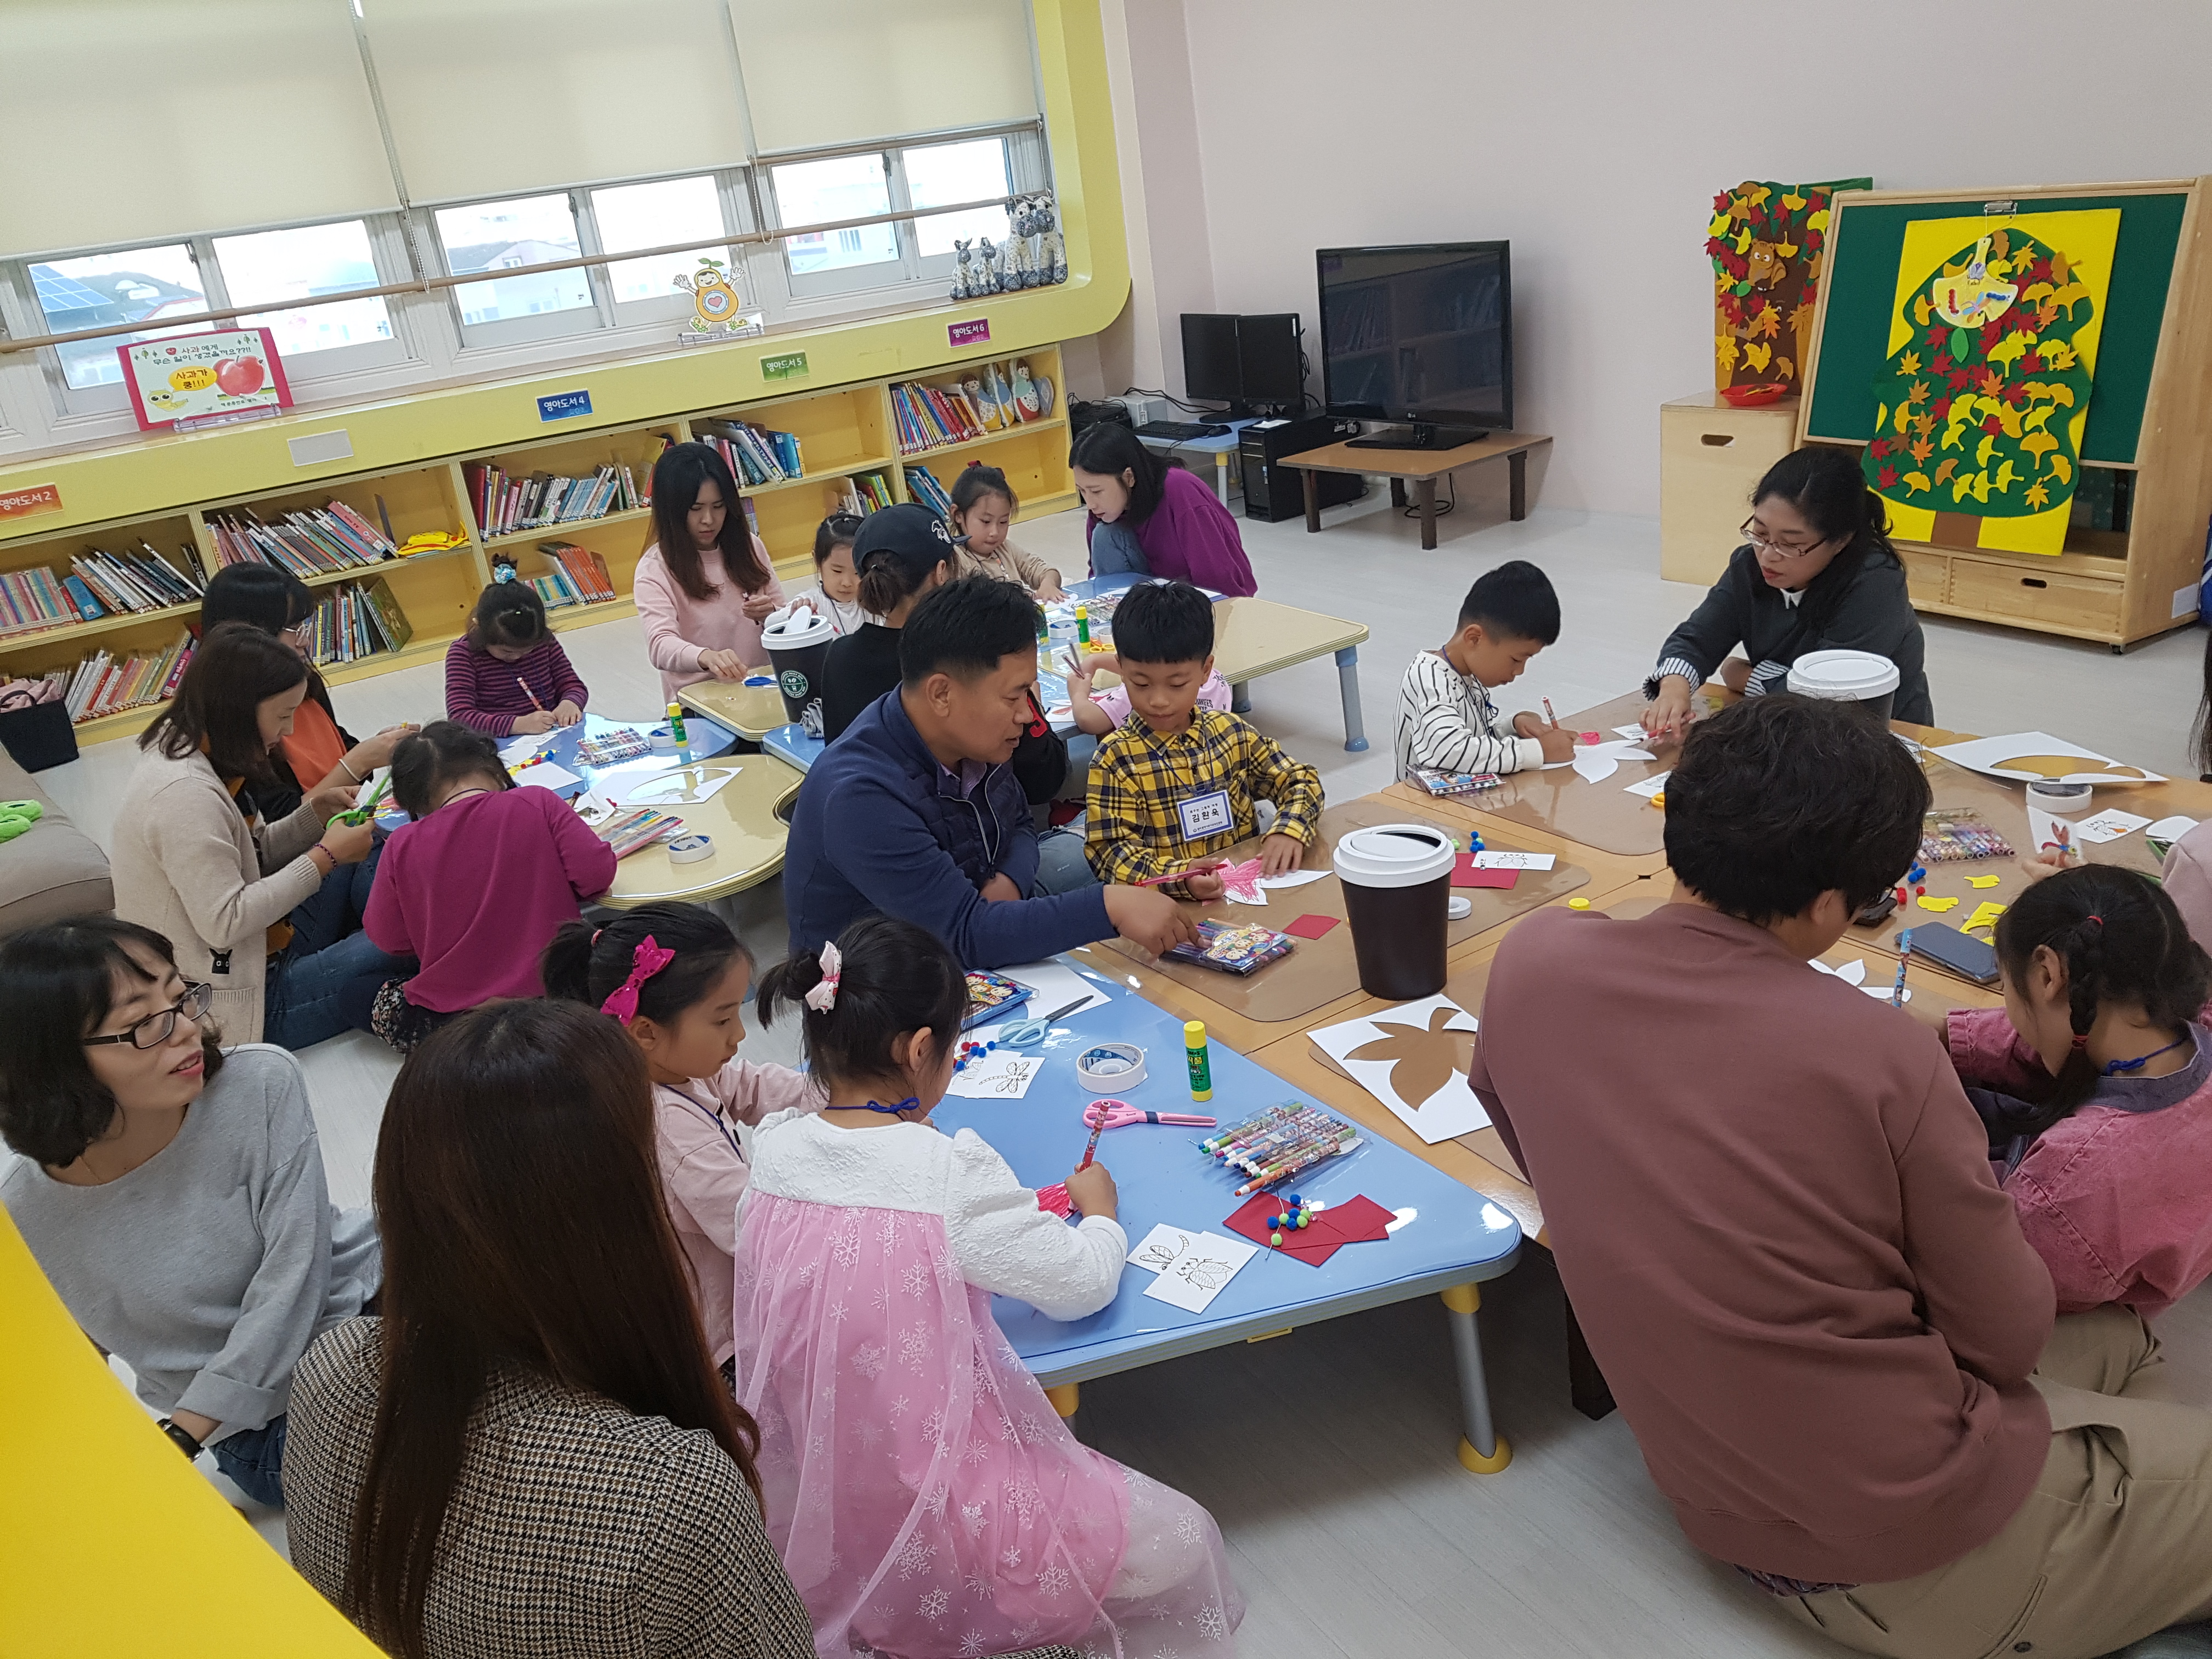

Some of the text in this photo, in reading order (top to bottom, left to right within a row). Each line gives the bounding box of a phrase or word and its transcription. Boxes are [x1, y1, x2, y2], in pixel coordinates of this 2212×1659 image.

[952, 325, 979, 338] 영아도서
[766, 357, 802, 372] 영아도서 5
[176, 369, 208, 380] 사과가
[183, 379, 205, 389] 쿵!!!
[544, 396, 585, 411] 영아도서 4
[0, 491, 52, 511] 영아도서 2
